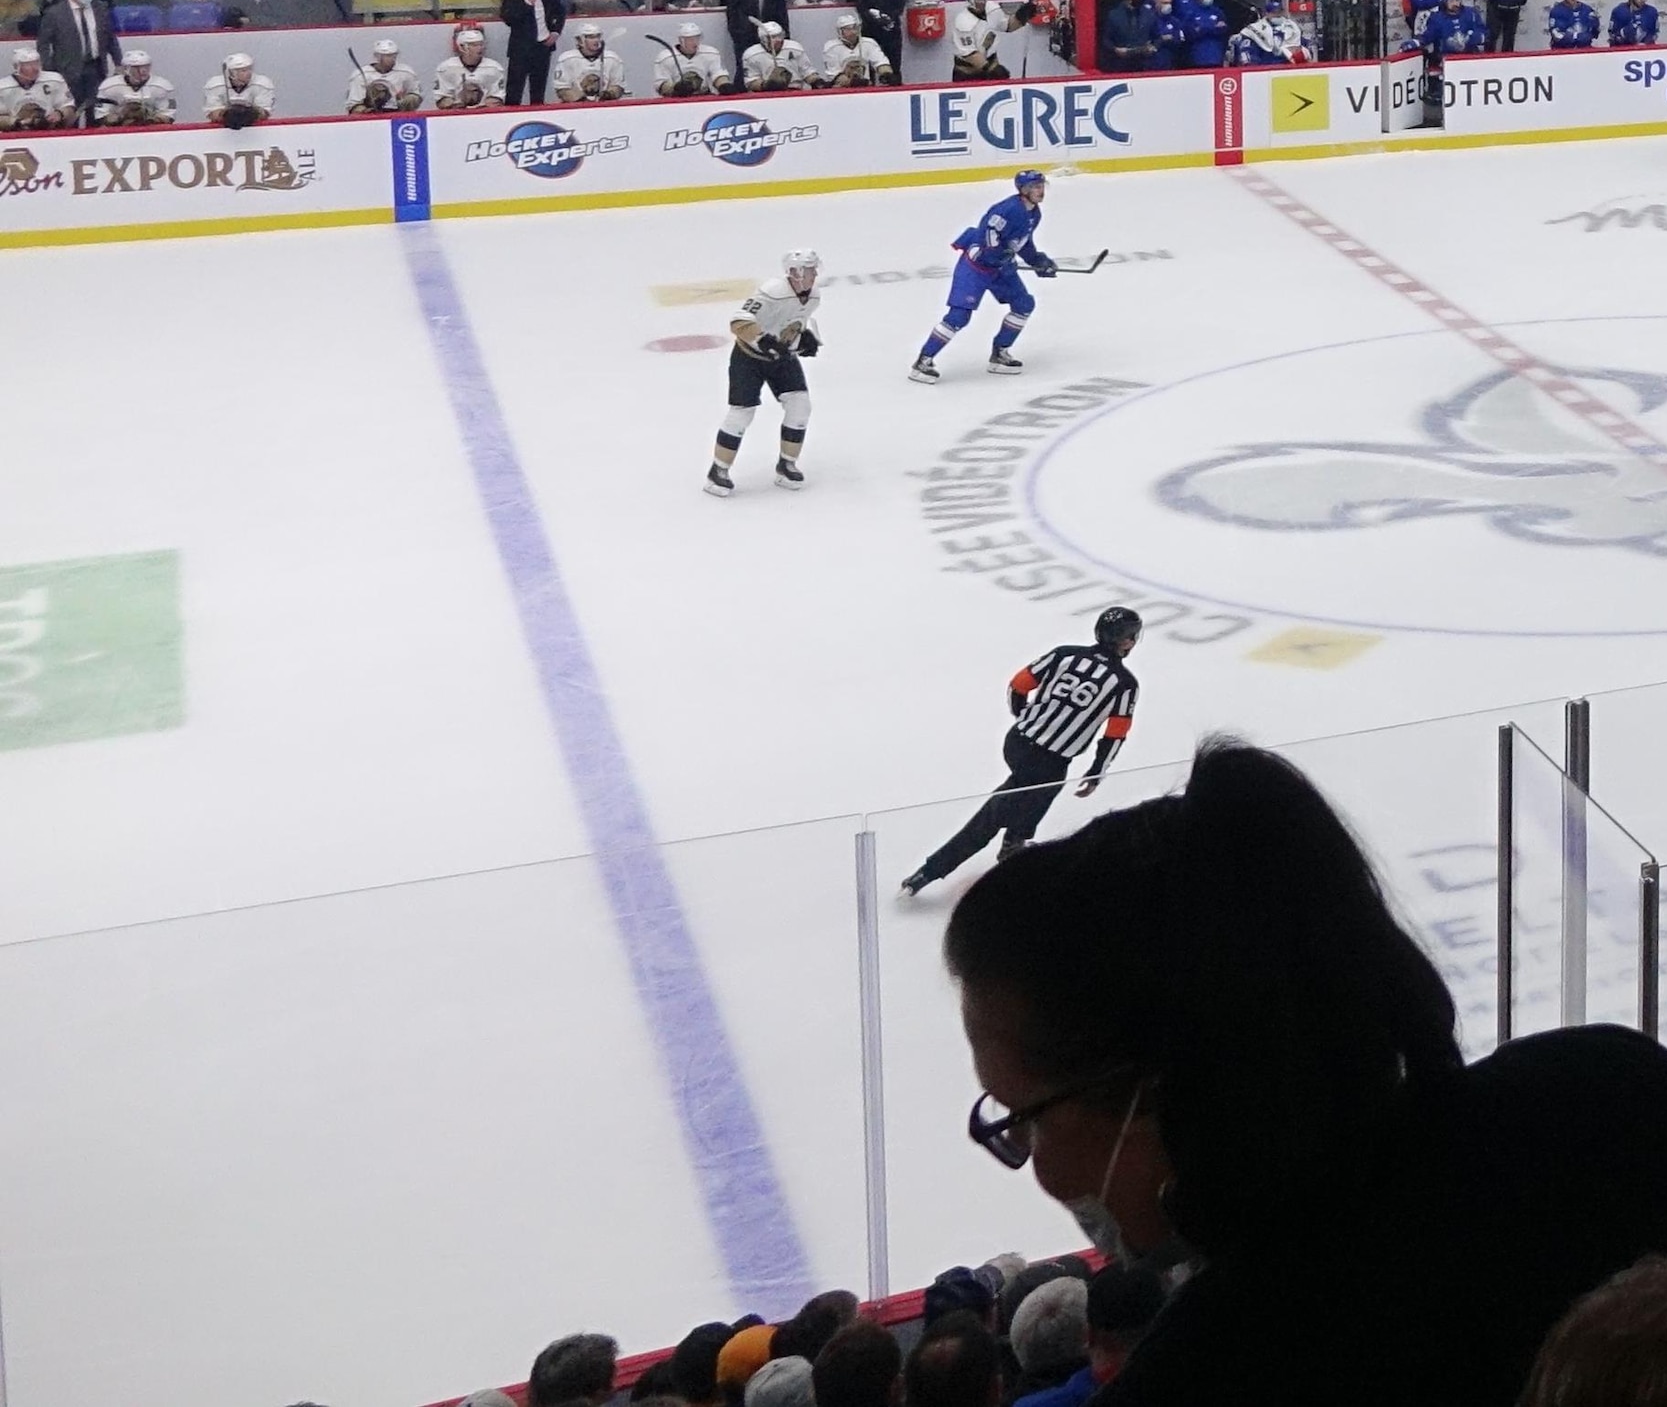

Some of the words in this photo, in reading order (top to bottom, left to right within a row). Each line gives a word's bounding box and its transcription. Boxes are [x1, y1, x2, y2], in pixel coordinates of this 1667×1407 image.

[911, 91, 968, 143] LE
[976, 83, 1132, 150] GREC
[517, 134, 630, 169] Experts
[713, 125, 819, 159] Experts
[70, 148, 266, 194] EXPORT
[301, 147, 316, 182] ALE
[742, 298, 763, 314] 22
[904, 375, 1152, 535] VIDÉOTRON
[1052, 672, 1099, 708] 26
